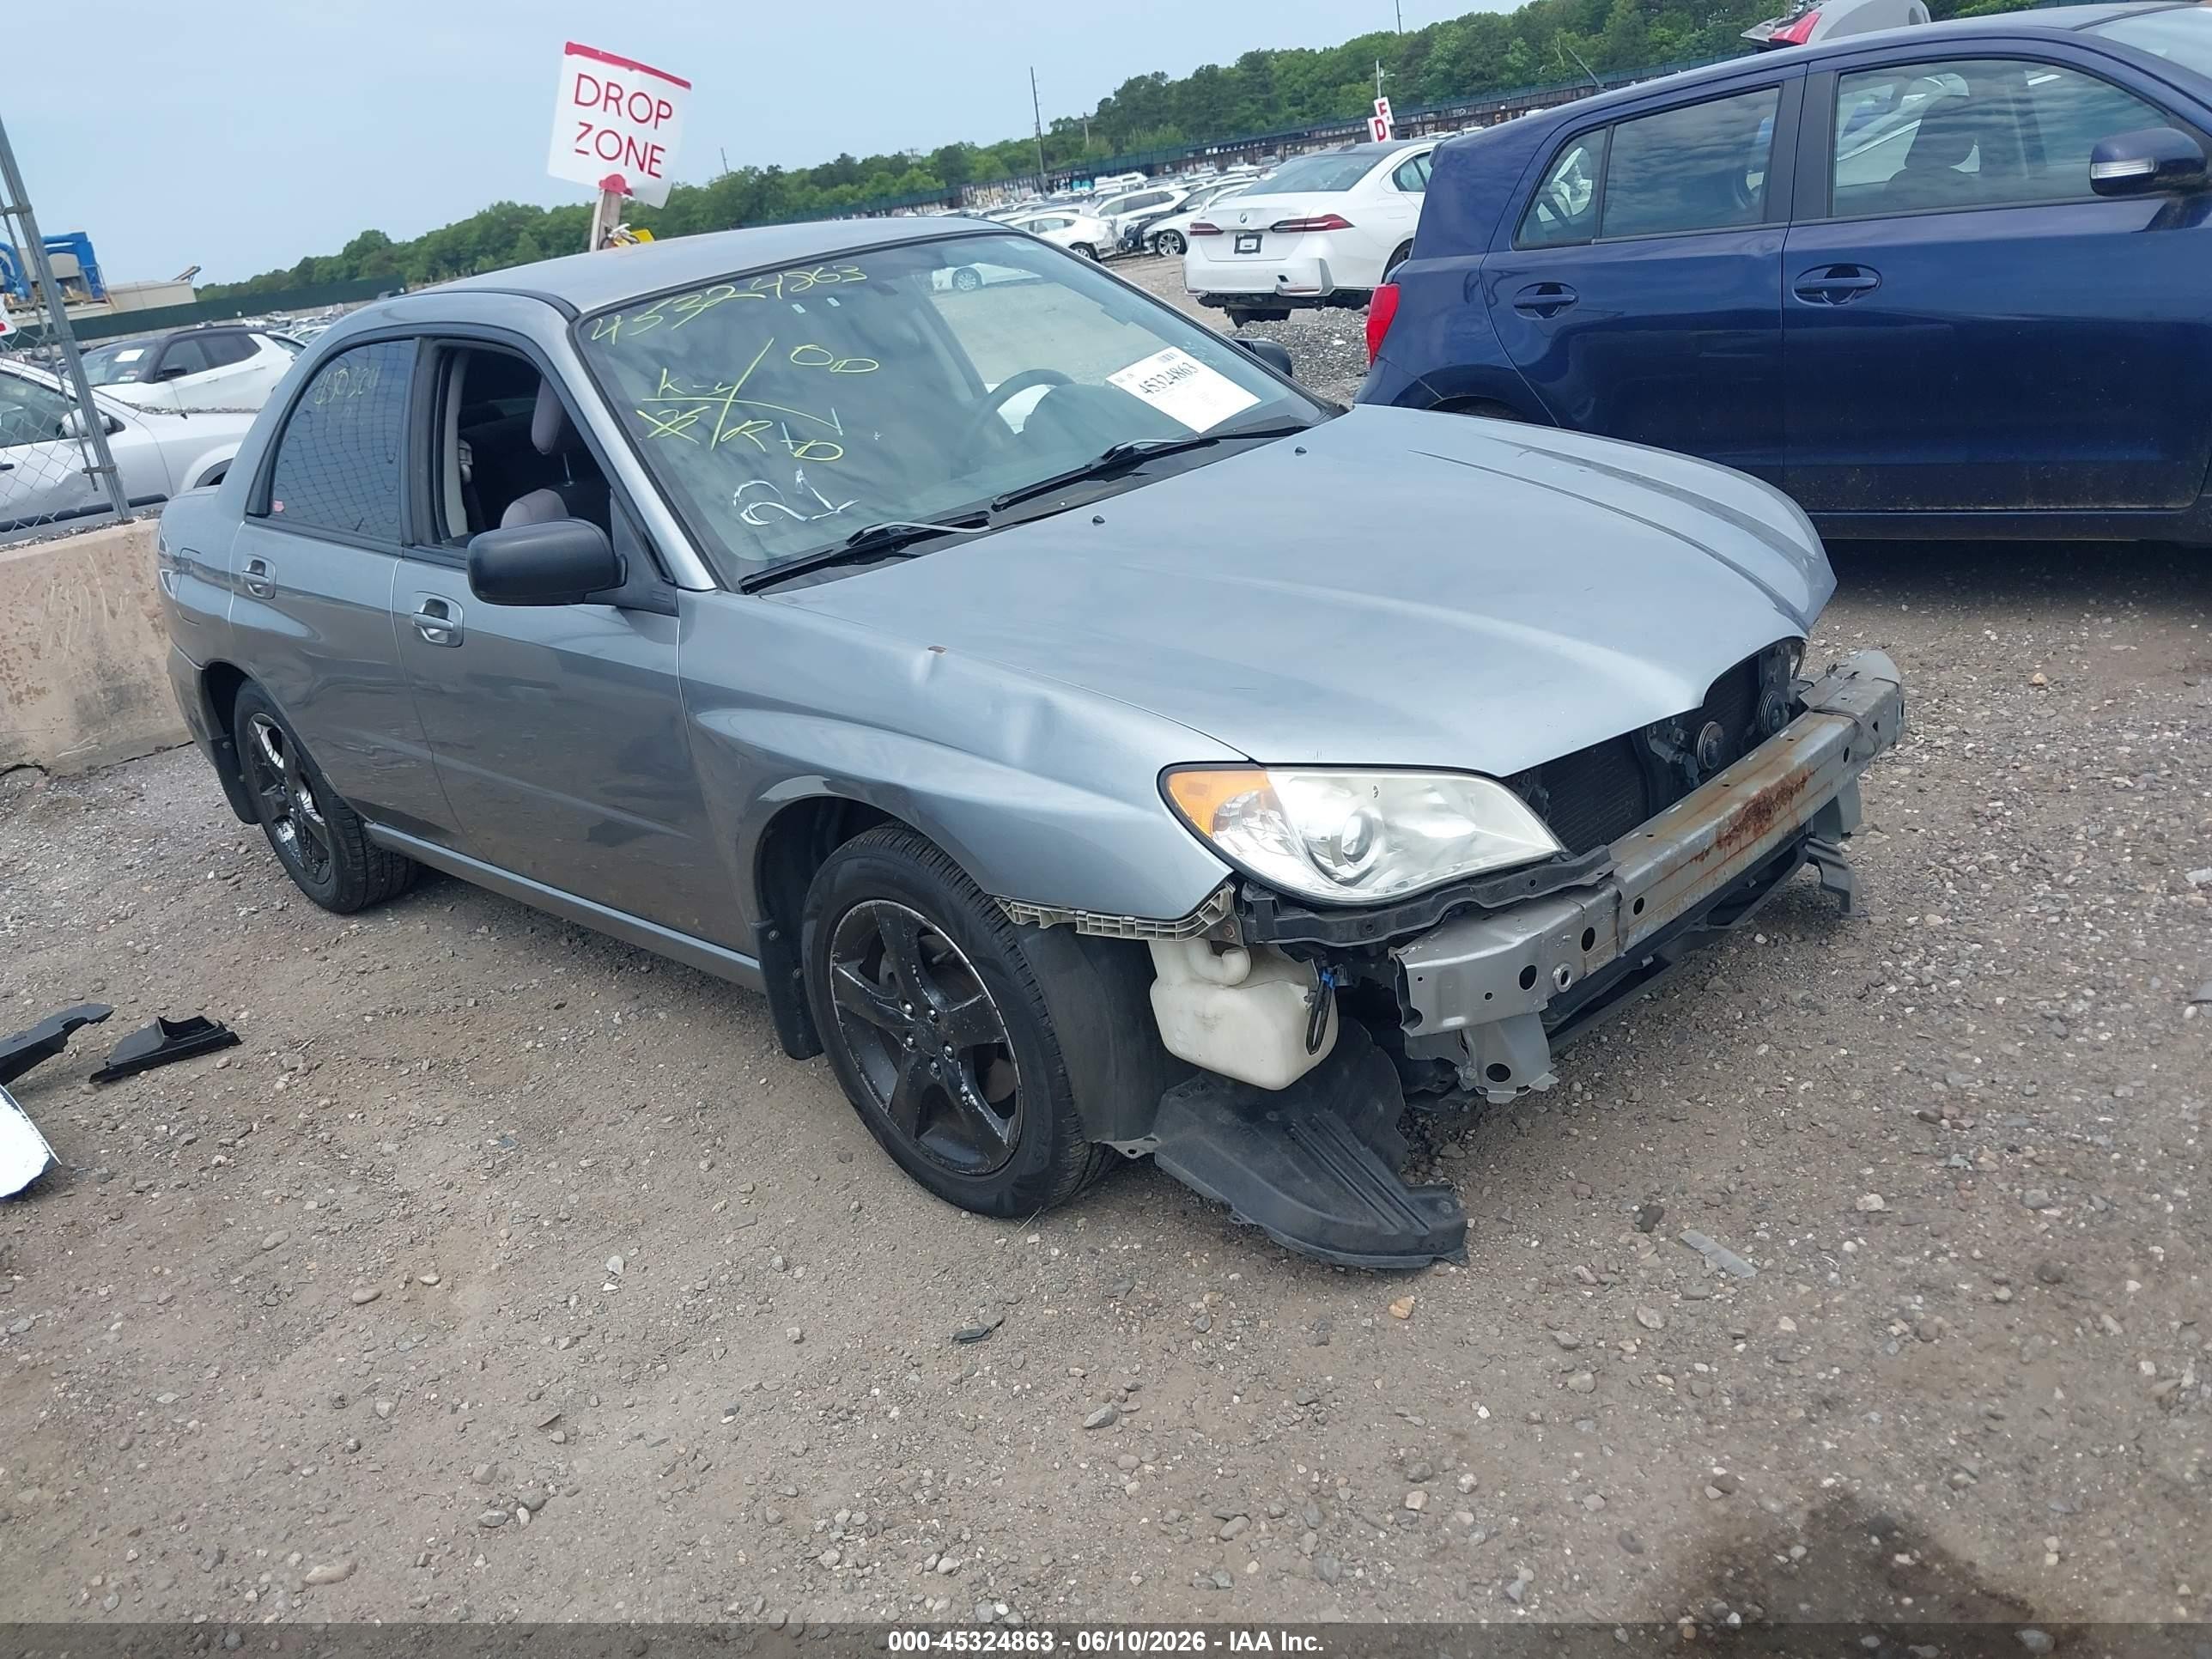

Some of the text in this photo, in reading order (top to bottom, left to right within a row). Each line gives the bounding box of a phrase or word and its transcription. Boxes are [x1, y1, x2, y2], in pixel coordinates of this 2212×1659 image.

[574, 73, 672, 130] DROP
[1374, 118, 1387, 142] D
[574, 121, 665, 179] ZONE
[591, 264, 868, 345] 45324863
[1139, 361, 1200, 395] 45324863
